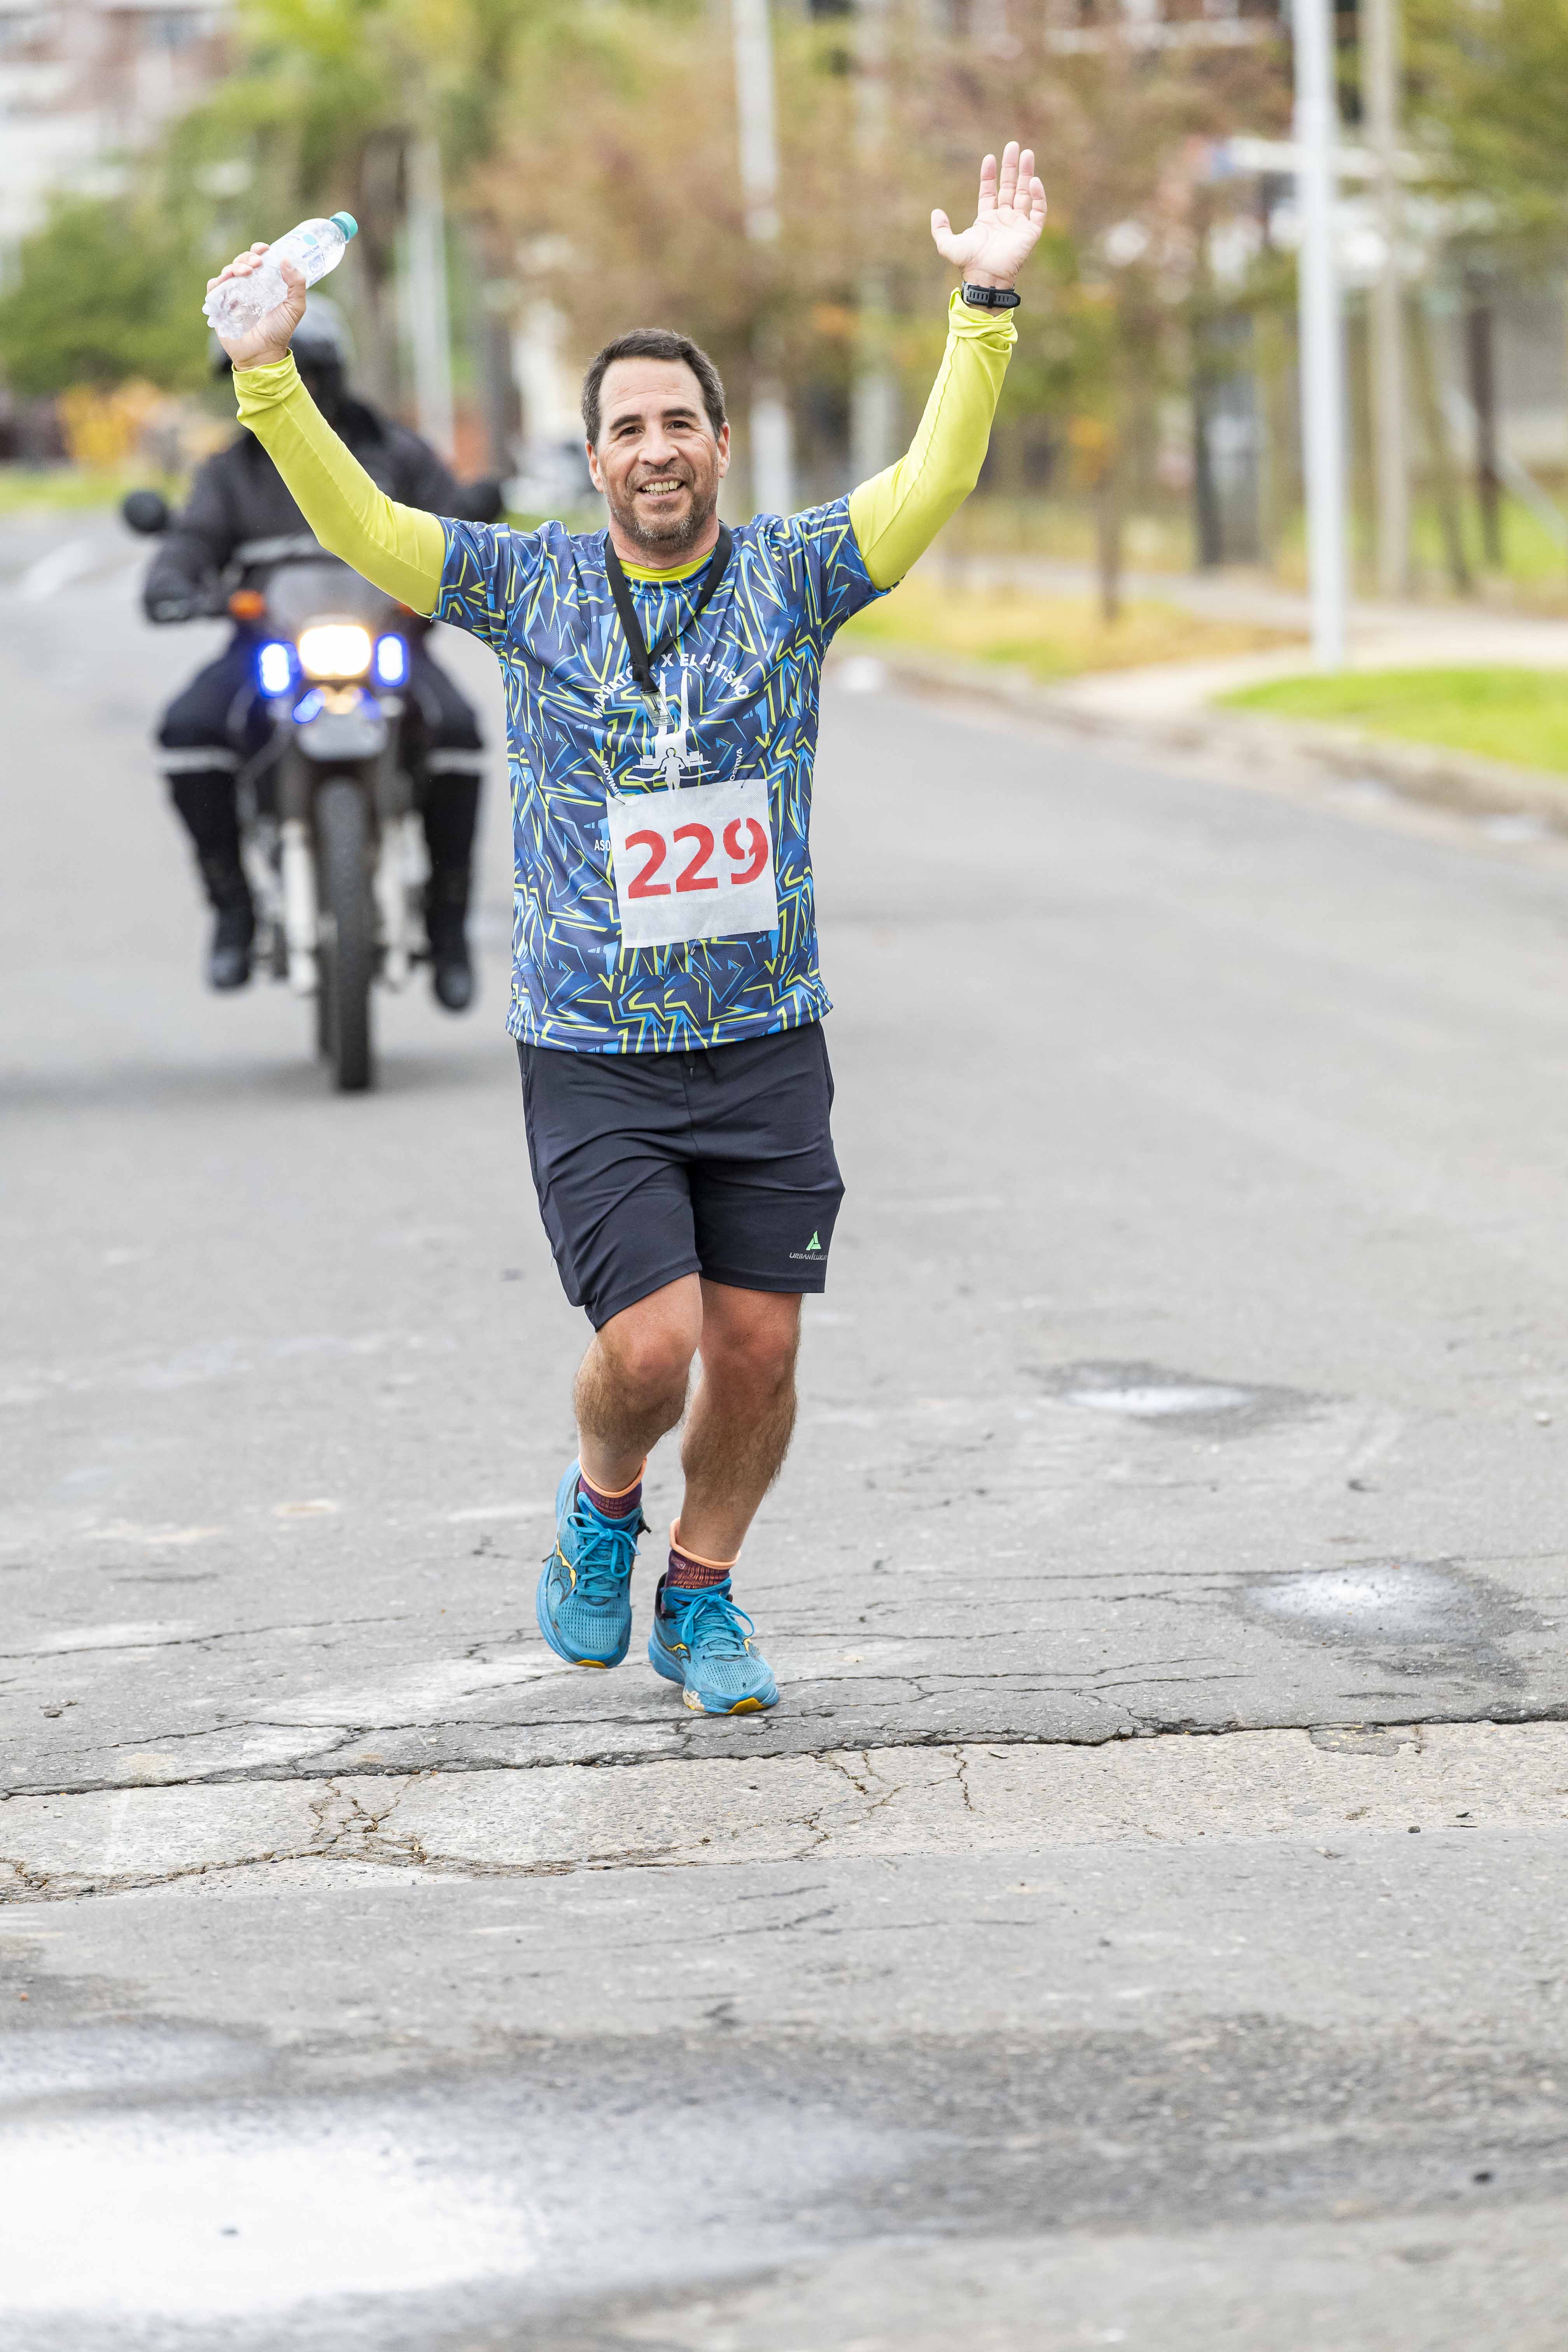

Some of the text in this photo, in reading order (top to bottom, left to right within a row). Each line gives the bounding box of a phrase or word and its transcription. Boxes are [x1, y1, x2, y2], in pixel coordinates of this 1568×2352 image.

[592, 662, 656, 718] MARATÓ
[661, 653, 674, 667] X
[680, 653, 697, 667] EL
[730, 747, 743, 781] OSITIVA
[625, 817, 768, 899] 229
